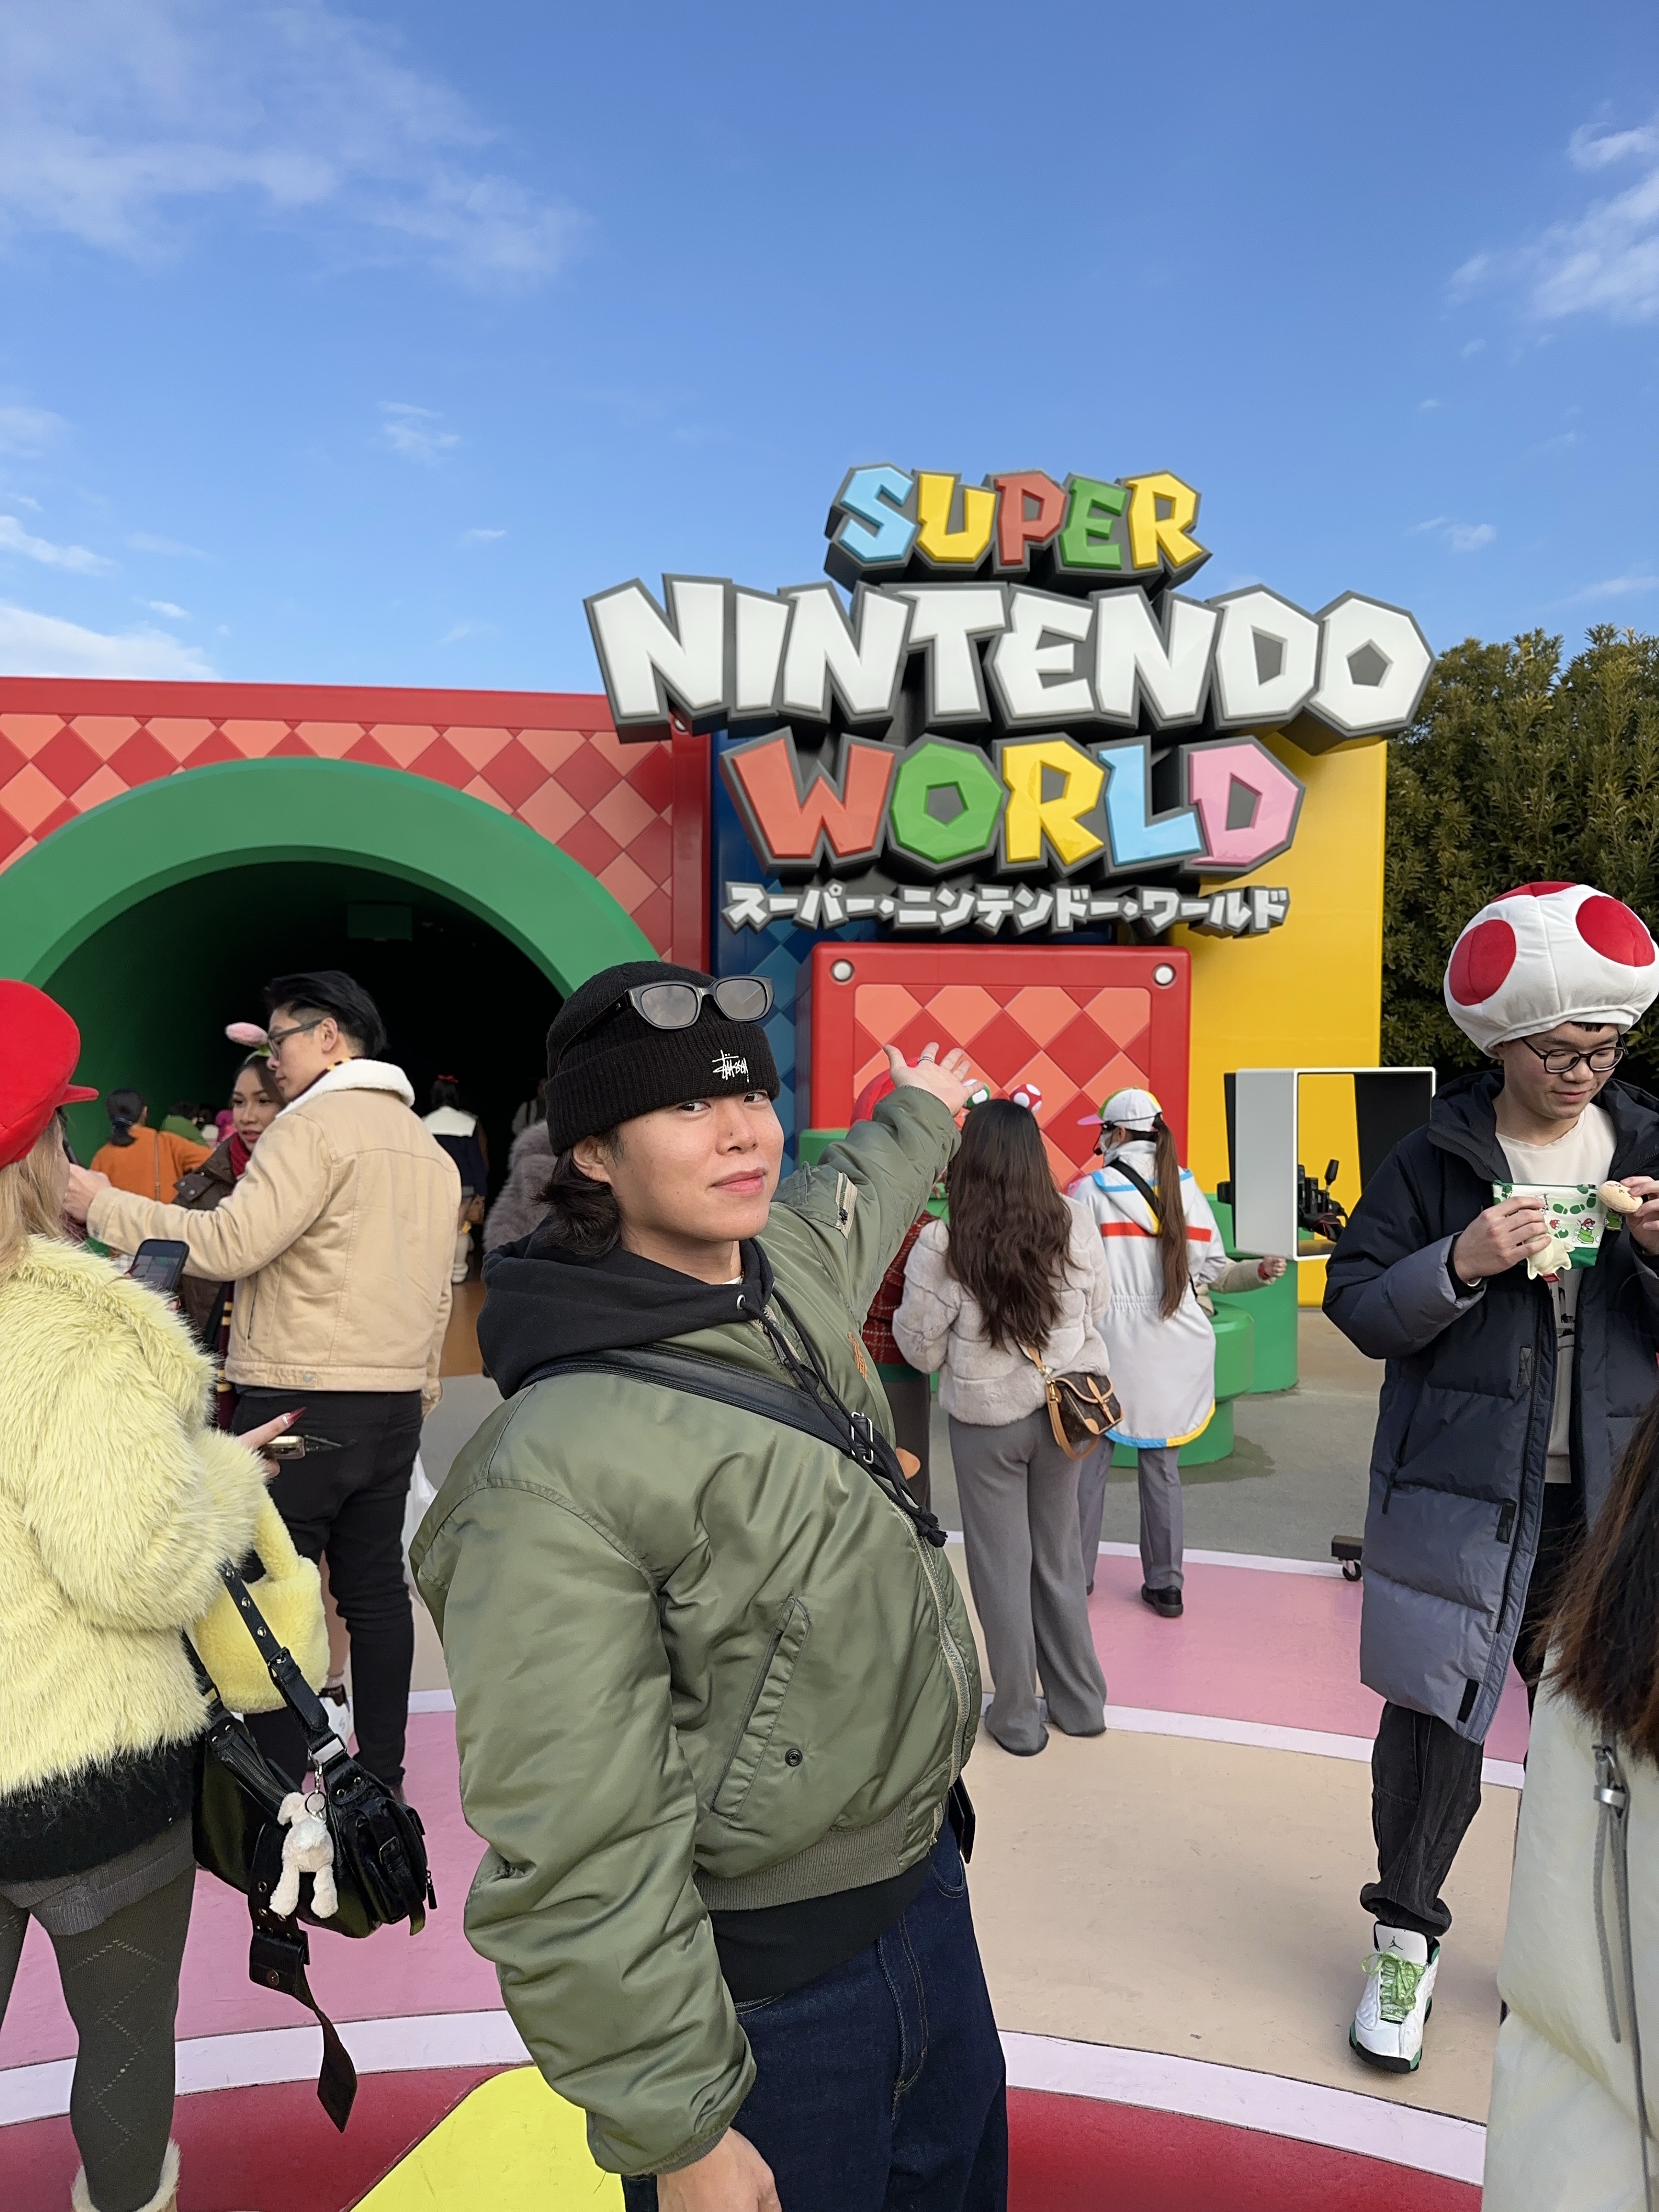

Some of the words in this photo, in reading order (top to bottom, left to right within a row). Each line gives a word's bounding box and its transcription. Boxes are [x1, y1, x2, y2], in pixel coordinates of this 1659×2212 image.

[837, 465, 1204, 570] SUPER
[590, 579, 1430, 729] NINTENDO
[731, 737, 1299, 867] WORLD
[727, 883, 1288, 930] スーパー・ニンテンドー・ワールド
